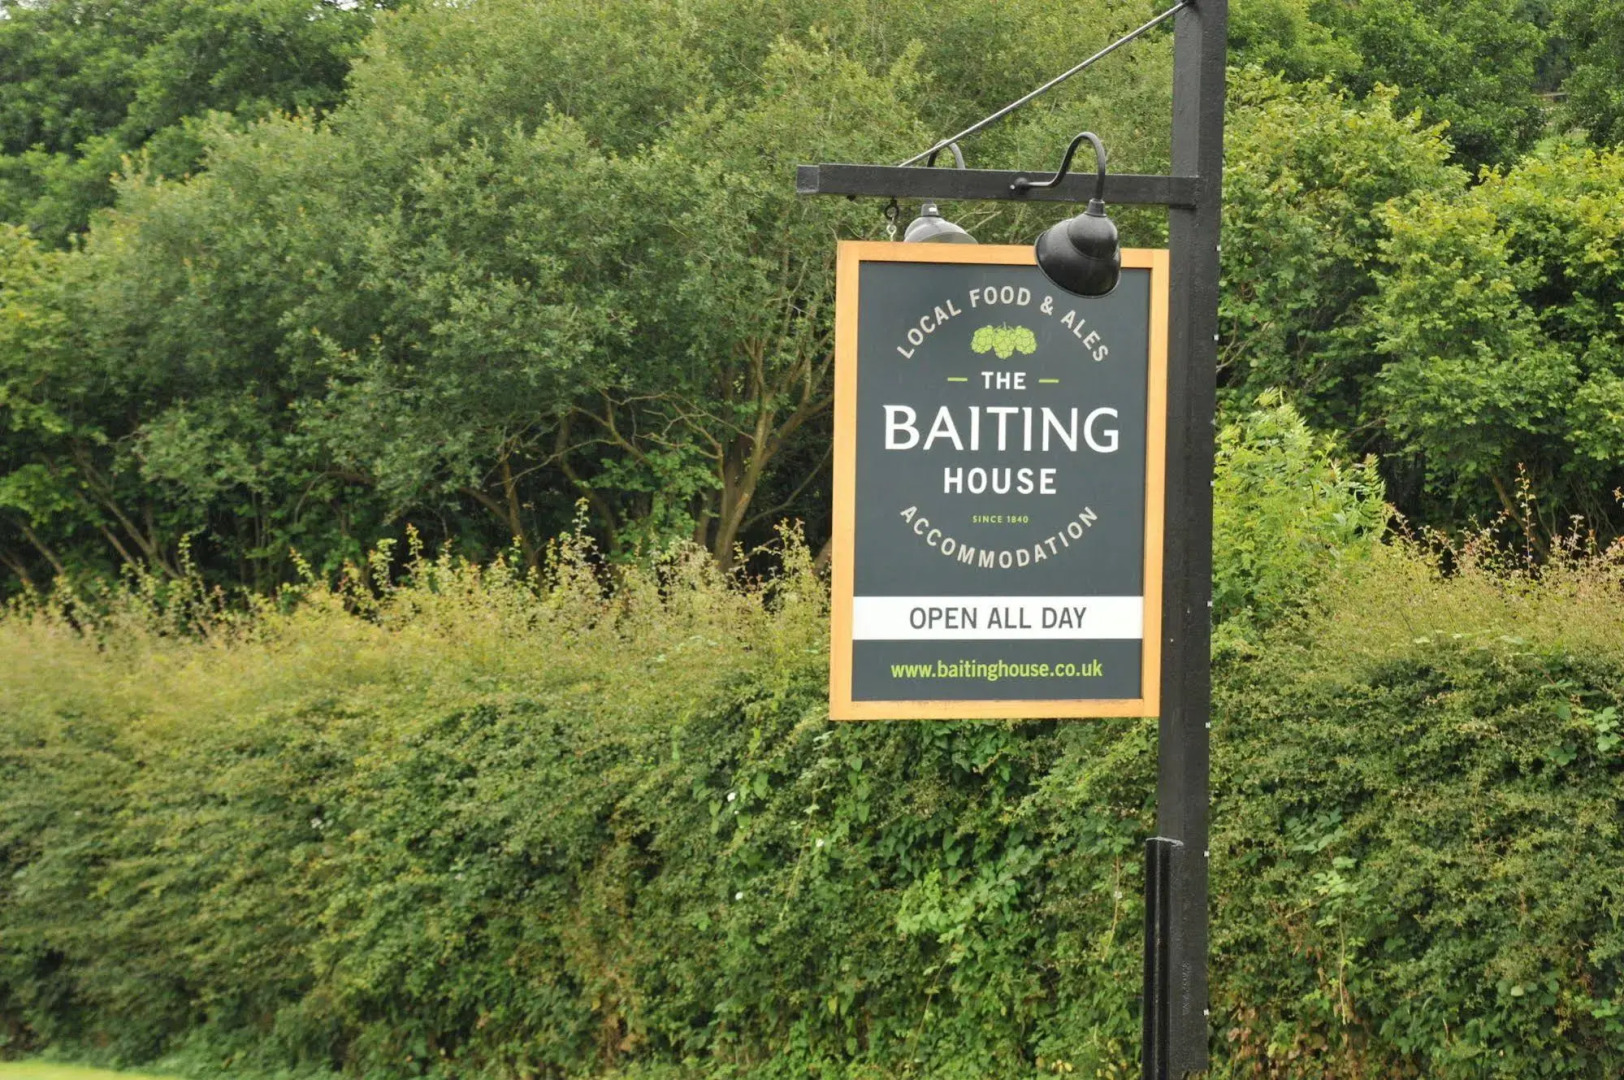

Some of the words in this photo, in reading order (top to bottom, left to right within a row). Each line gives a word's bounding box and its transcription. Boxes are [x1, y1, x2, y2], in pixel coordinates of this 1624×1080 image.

[897, 299, 962, 359] LOCAL
[969, 286, 1031, 308] FOOD
[1040, 295, 1054, 315] &
[1060, 310, 1109, 362] ALES
[981, 371, 1026, 389] THE
[883, 404, 1119, 453] BAITING
[943, 467, 1057, 495] HOUSE
[972, 515, 1002, 524] SINCE
[1006, 515, 1029, 524] 1840
[900, 505, 1098, 569] ACCOMMODATION
[909, 607, 978, 630] OPEN
[987, 607, 1032, 629] ALL
[1041, 607, 1087, 629] DAY
[891, 659, 1103, 682] www.baitinghouse.co.uk
